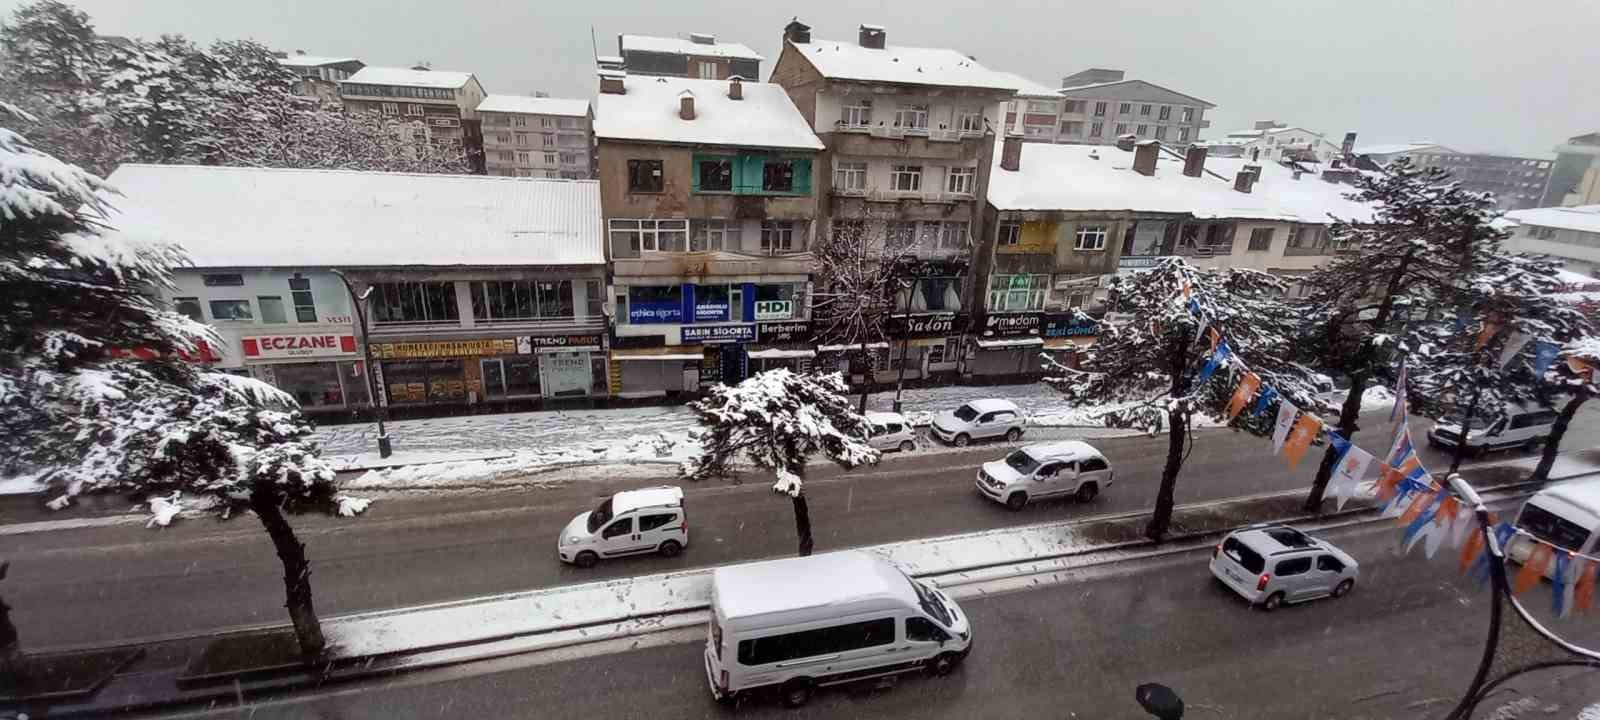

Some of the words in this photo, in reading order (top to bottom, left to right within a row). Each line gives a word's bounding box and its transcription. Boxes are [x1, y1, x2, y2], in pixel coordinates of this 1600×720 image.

[757, 302, 790, 313] HDI
[762, 324, 807, 333] Berberim
[907, 319, 952, 332] Salon
[261, 335, 337, 350] ECZANE
[533, 337, 566, 345] TREND
